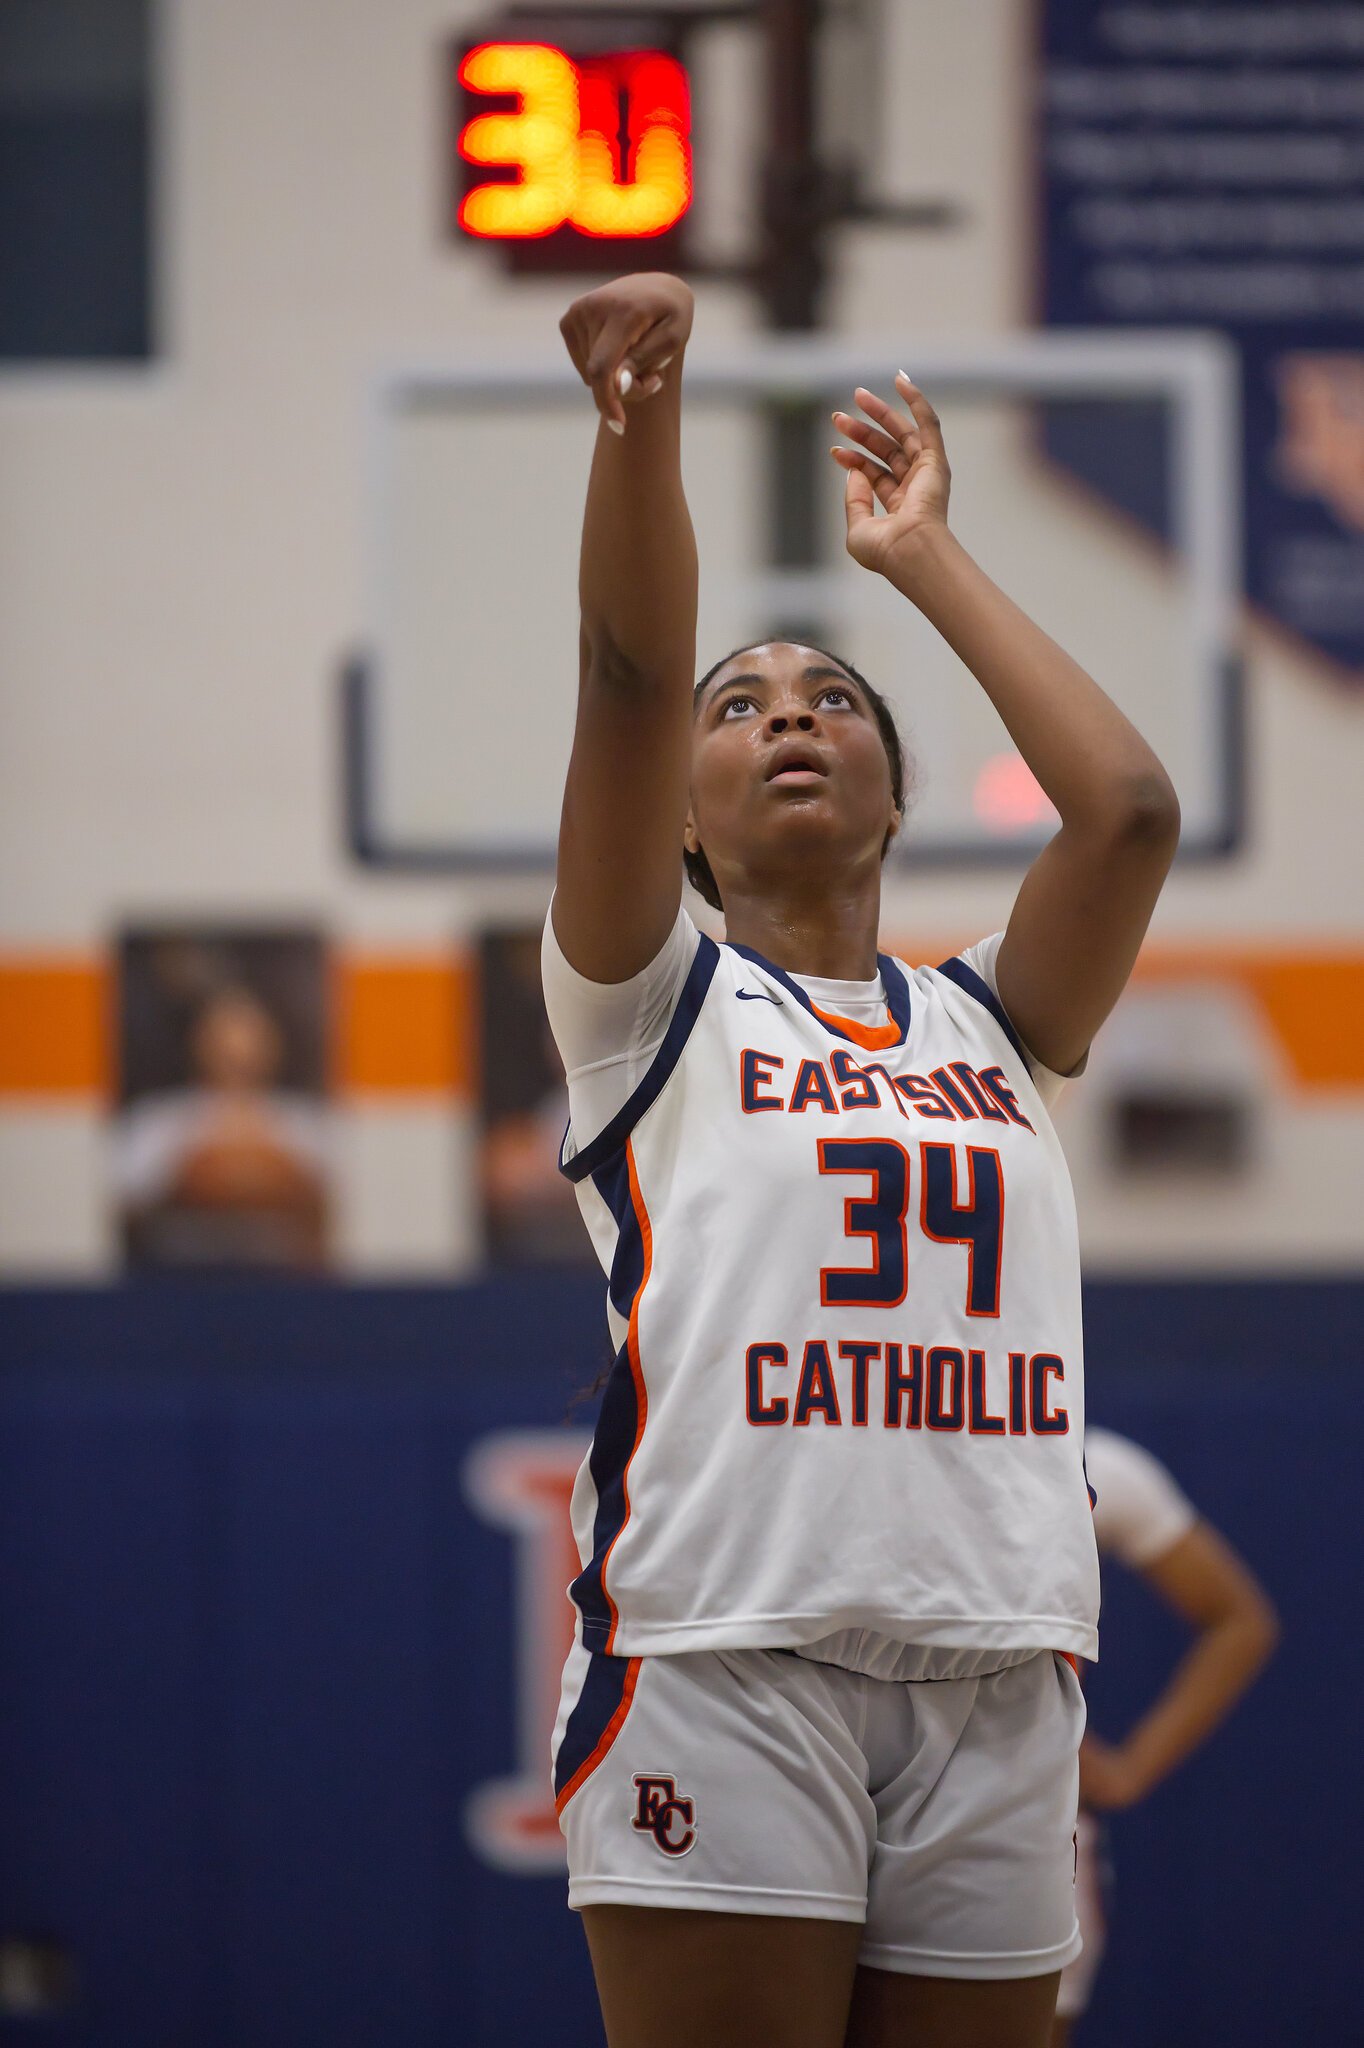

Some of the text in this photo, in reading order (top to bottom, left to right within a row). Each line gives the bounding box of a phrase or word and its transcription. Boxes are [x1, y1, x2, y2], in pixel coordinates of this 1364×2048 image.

[816, 1137, 1005, 1318] 34
[745, 1340, 1070, 1436] CATHOLIC
[633, 1777, 694, 1855] EC
